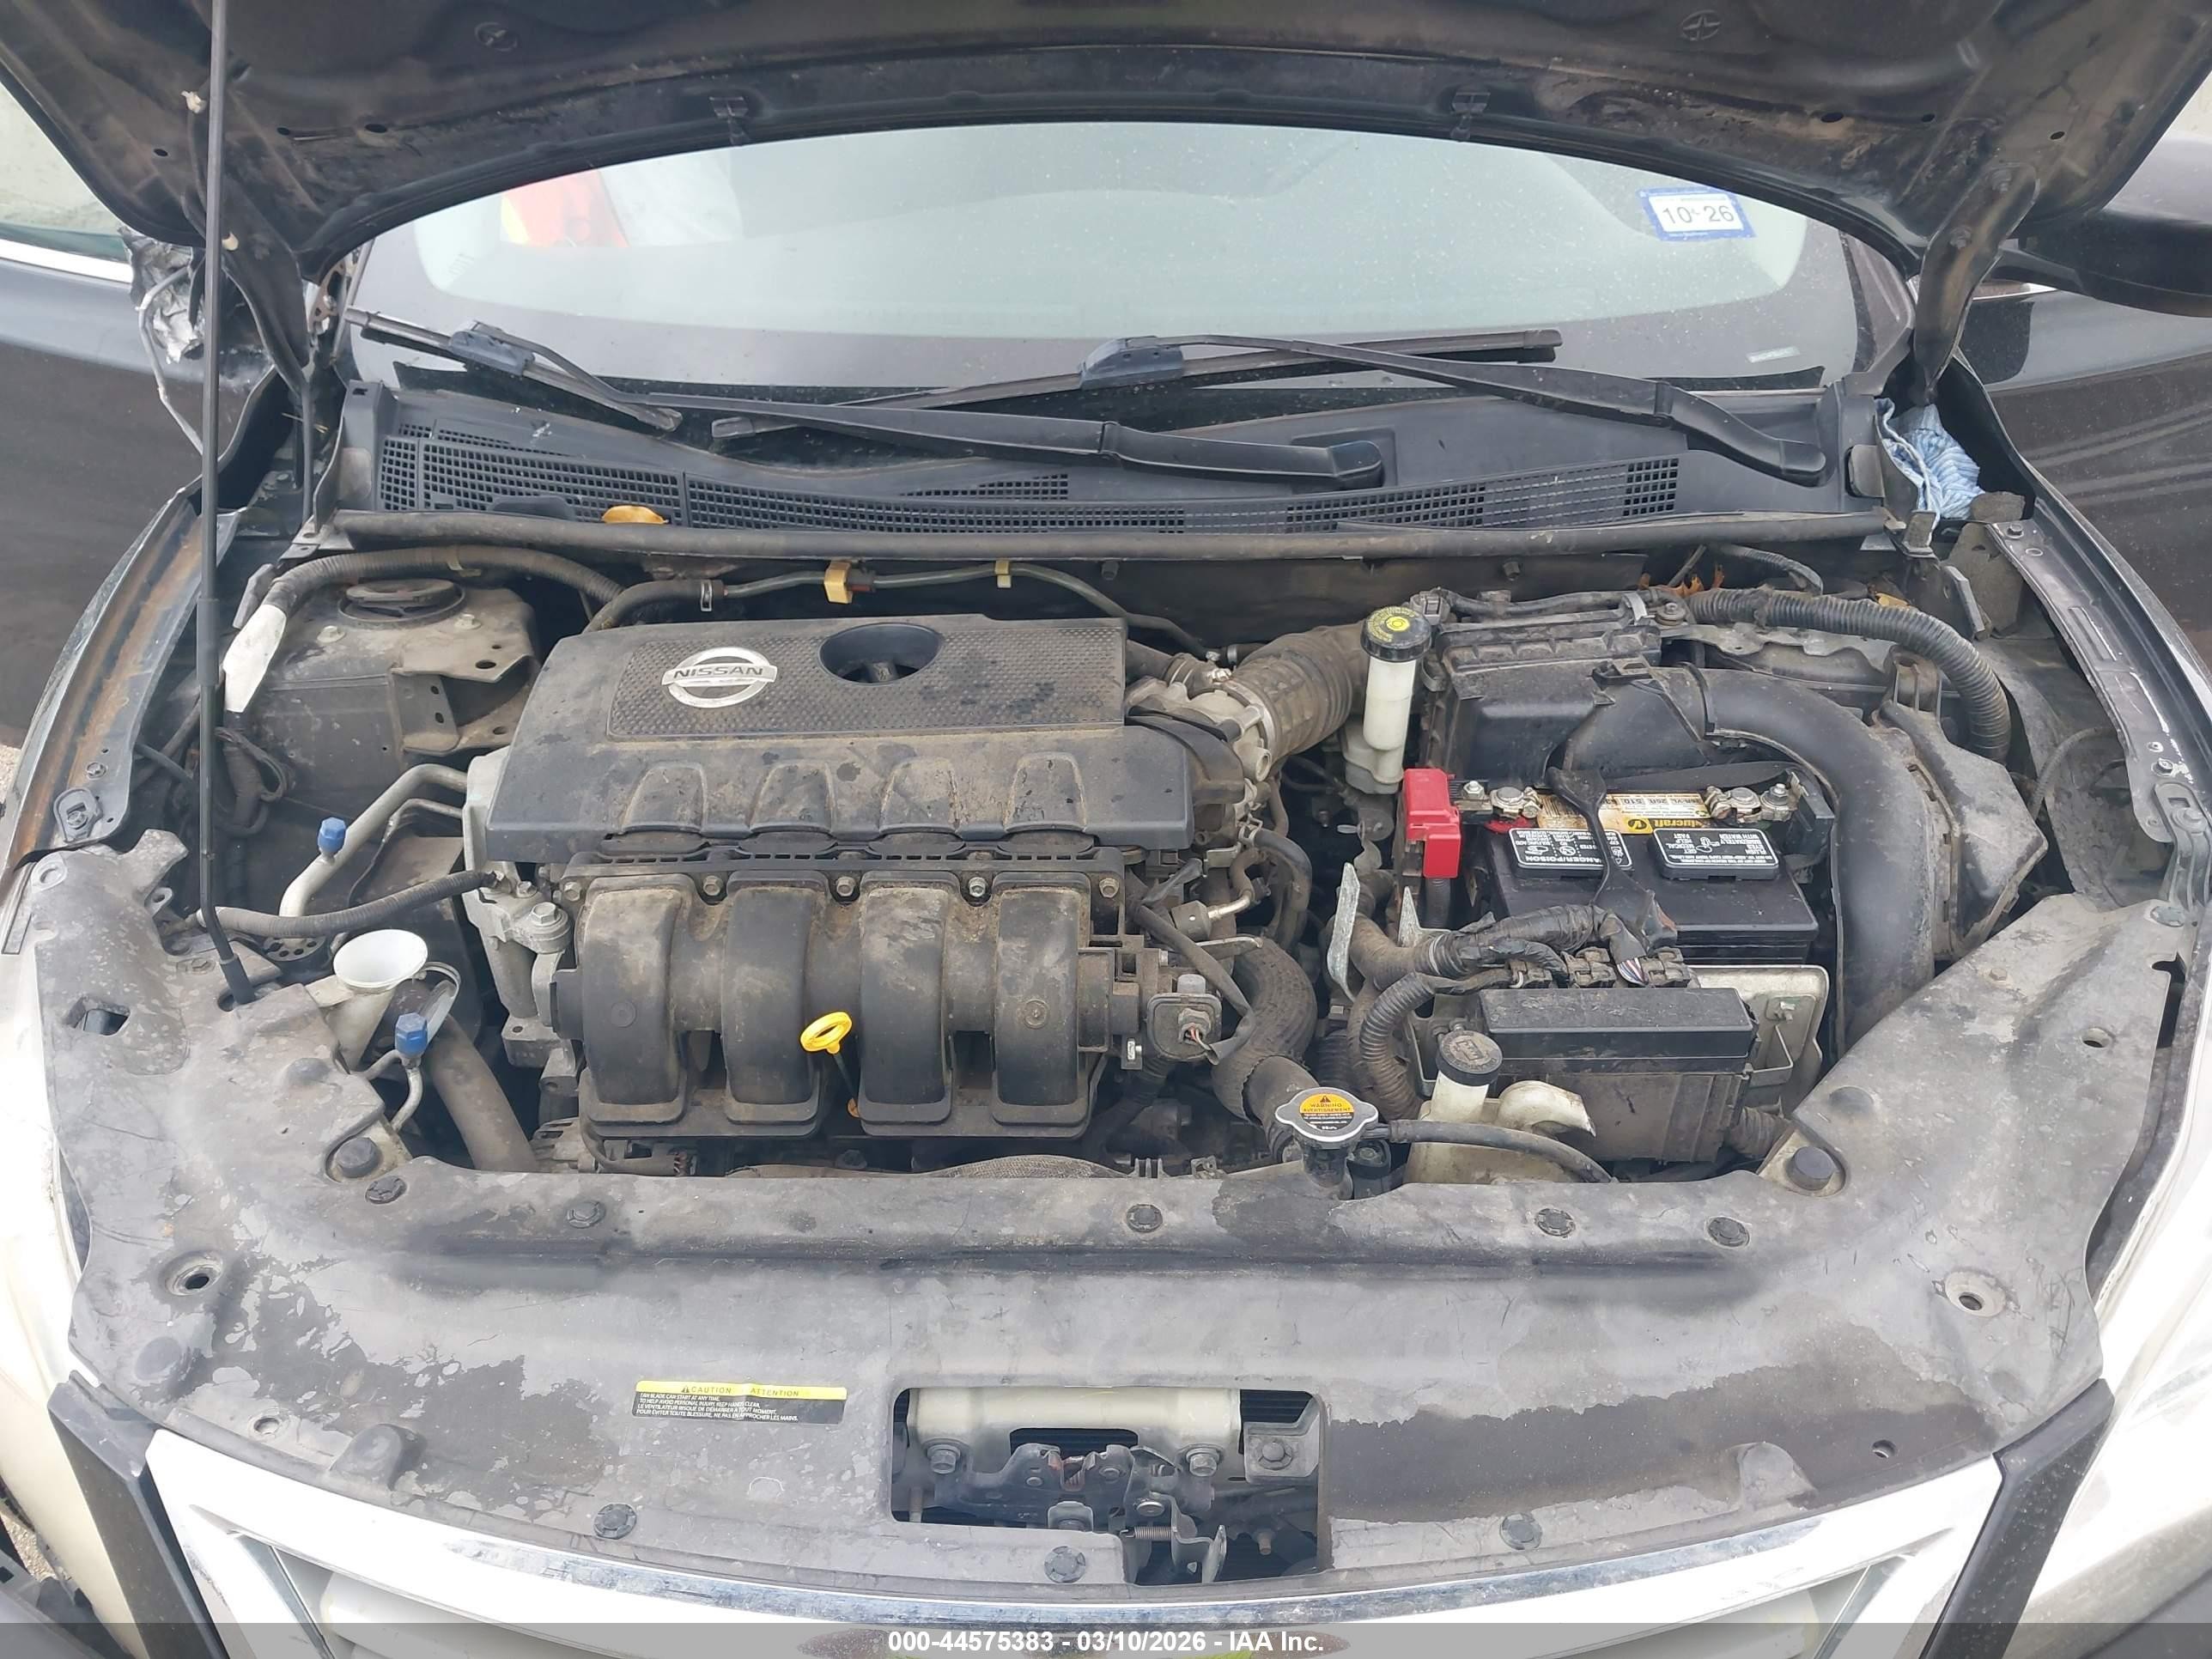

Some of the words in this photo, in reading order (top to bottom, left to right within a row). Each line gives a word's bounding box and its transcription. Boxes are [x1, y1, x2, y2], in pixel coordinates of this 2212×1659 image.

[1662, 206, 1692, 224] 10
[1704, 205, 1735, 222] 26
[673, 666, 763, 678] NISSAN
[750, 1387, 799, 1397] ATTENTION
